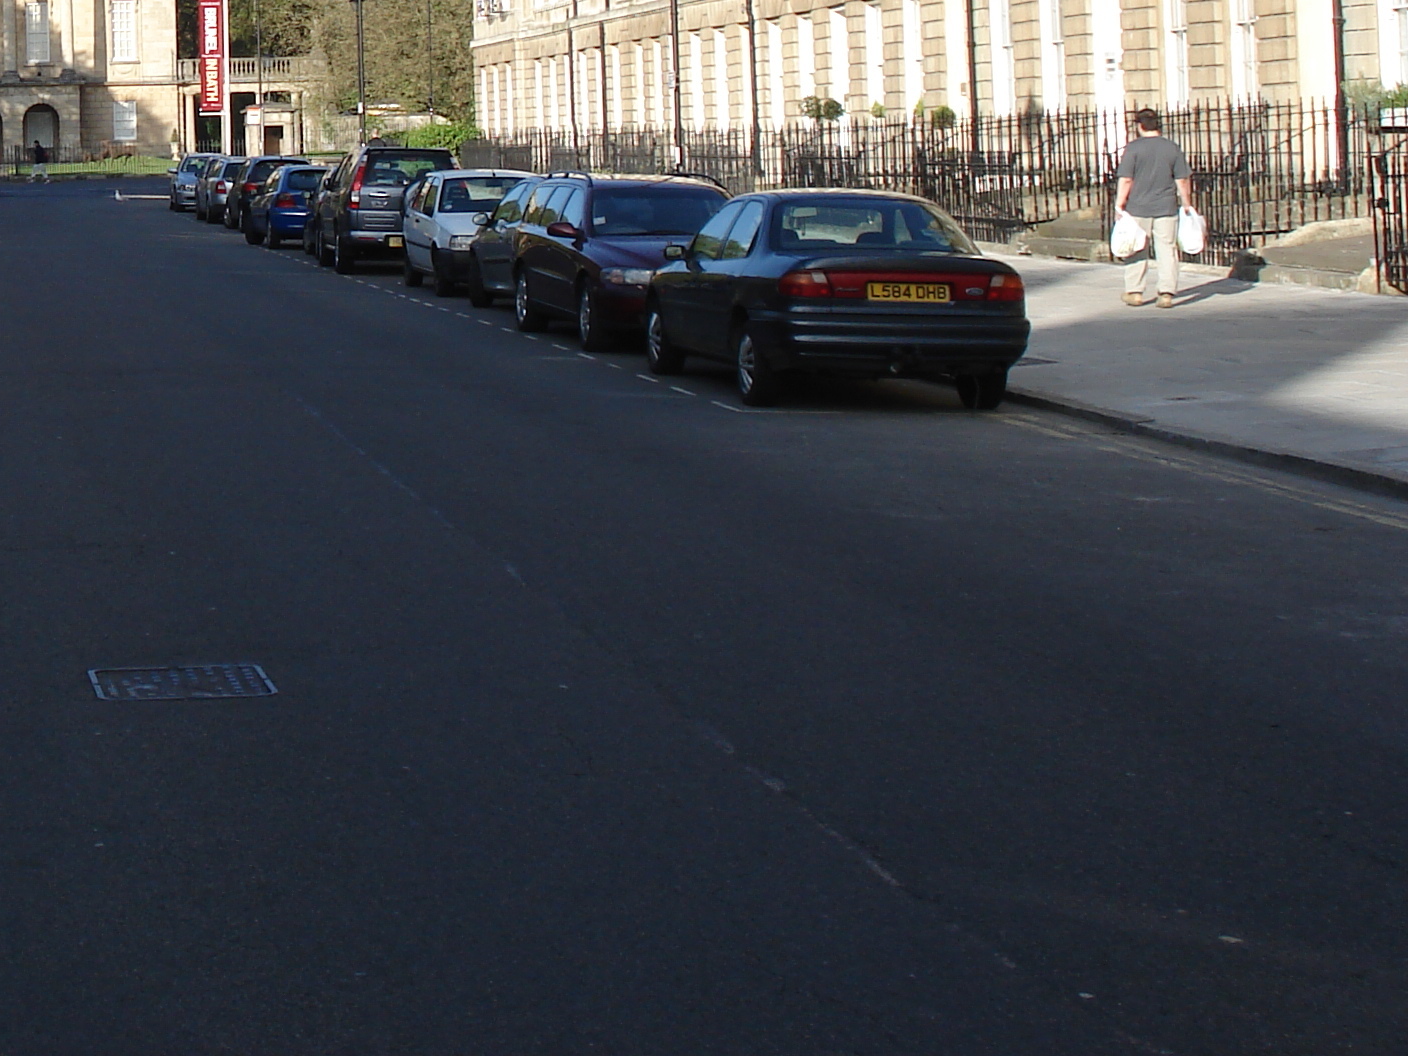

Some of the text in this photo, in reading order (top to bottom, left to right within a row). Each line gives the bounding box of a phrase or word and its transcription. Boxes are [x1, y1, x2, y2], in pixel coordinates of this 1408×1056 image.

[204, 7, 217, 54] BRUNEL
[871, 284, 946, 300] L584 DHB
